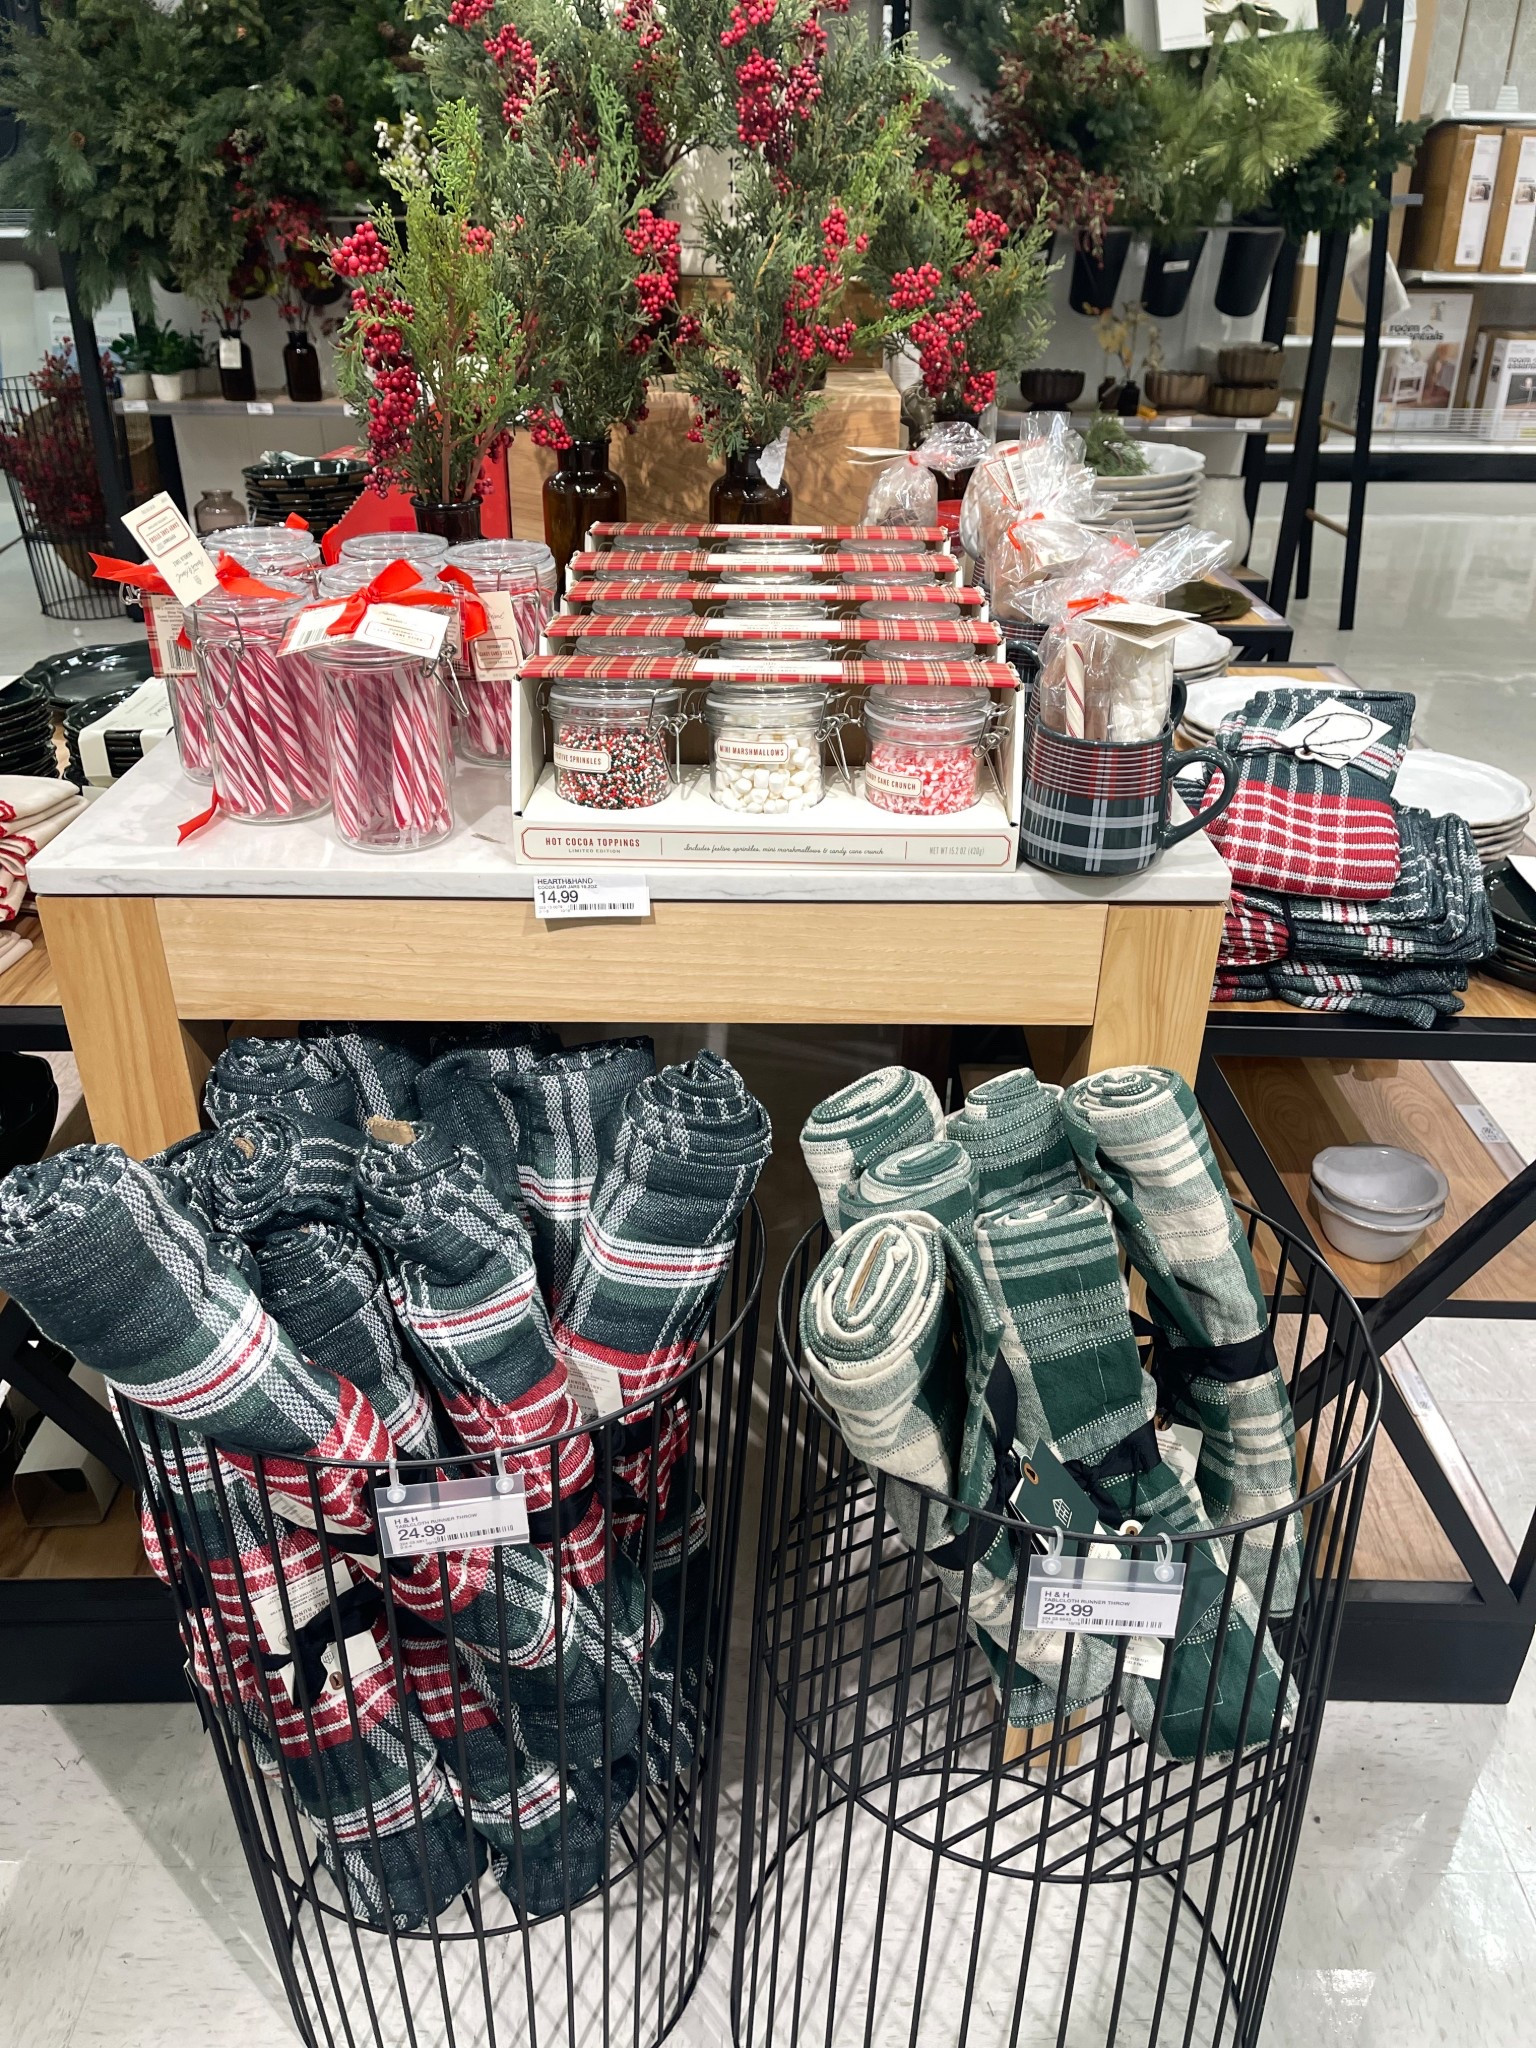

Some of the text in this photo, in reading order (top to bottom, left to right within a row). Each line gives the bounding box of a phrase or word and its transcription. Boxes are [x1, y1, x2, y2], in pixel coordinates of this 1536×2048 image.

[1389, 324, 1421, 333] room
[720, 744, 784, 757] MINI MARSHMALLOWS
[570, 755, 602, 766] SPRINKLES
[878, 776, 890, 786] CANE
[891, 780, 916, 791] CRUNCH
[545, 837, 640, 848] HOT COCOA TOPPINGS
[711, 844, 731, 853] festive
[777, 846, 821, 854] marshmallows
[829, 846, 846, 856] candy
[539, 890, 579, 904] 14.99
[430, 1516, 456, 1524] RUNNER
[398, 1524, 446, 1542] 24.99
[1043, 1602, 1094, 1617] 22.99
